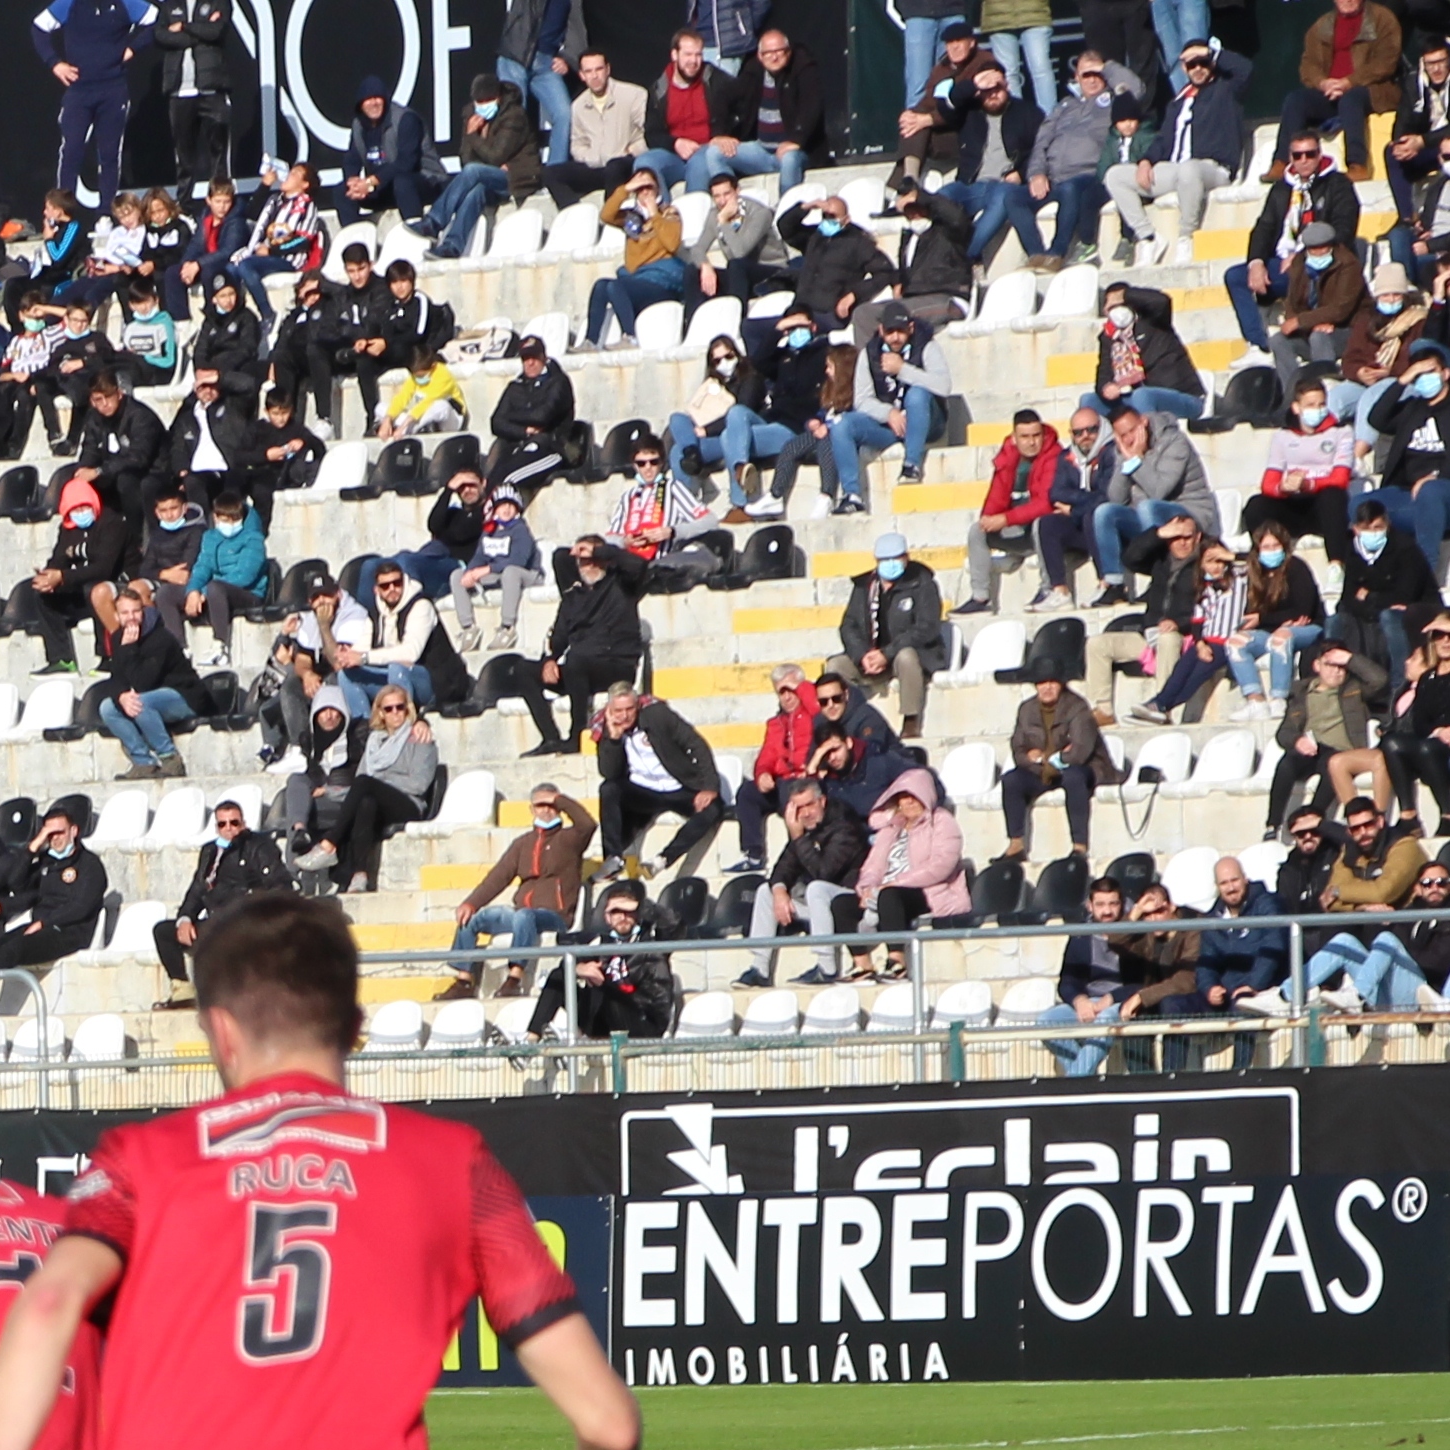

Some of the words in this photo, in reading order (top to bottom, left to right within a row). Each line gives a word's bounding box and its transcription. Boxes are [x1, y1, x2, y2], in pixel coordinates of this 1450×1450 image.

[227, 1153, 358, 1199] RUCA
[235, 1199, 338, 1367] 5
[625, 1332, 949, 1387] IMOBILIÁRIA
